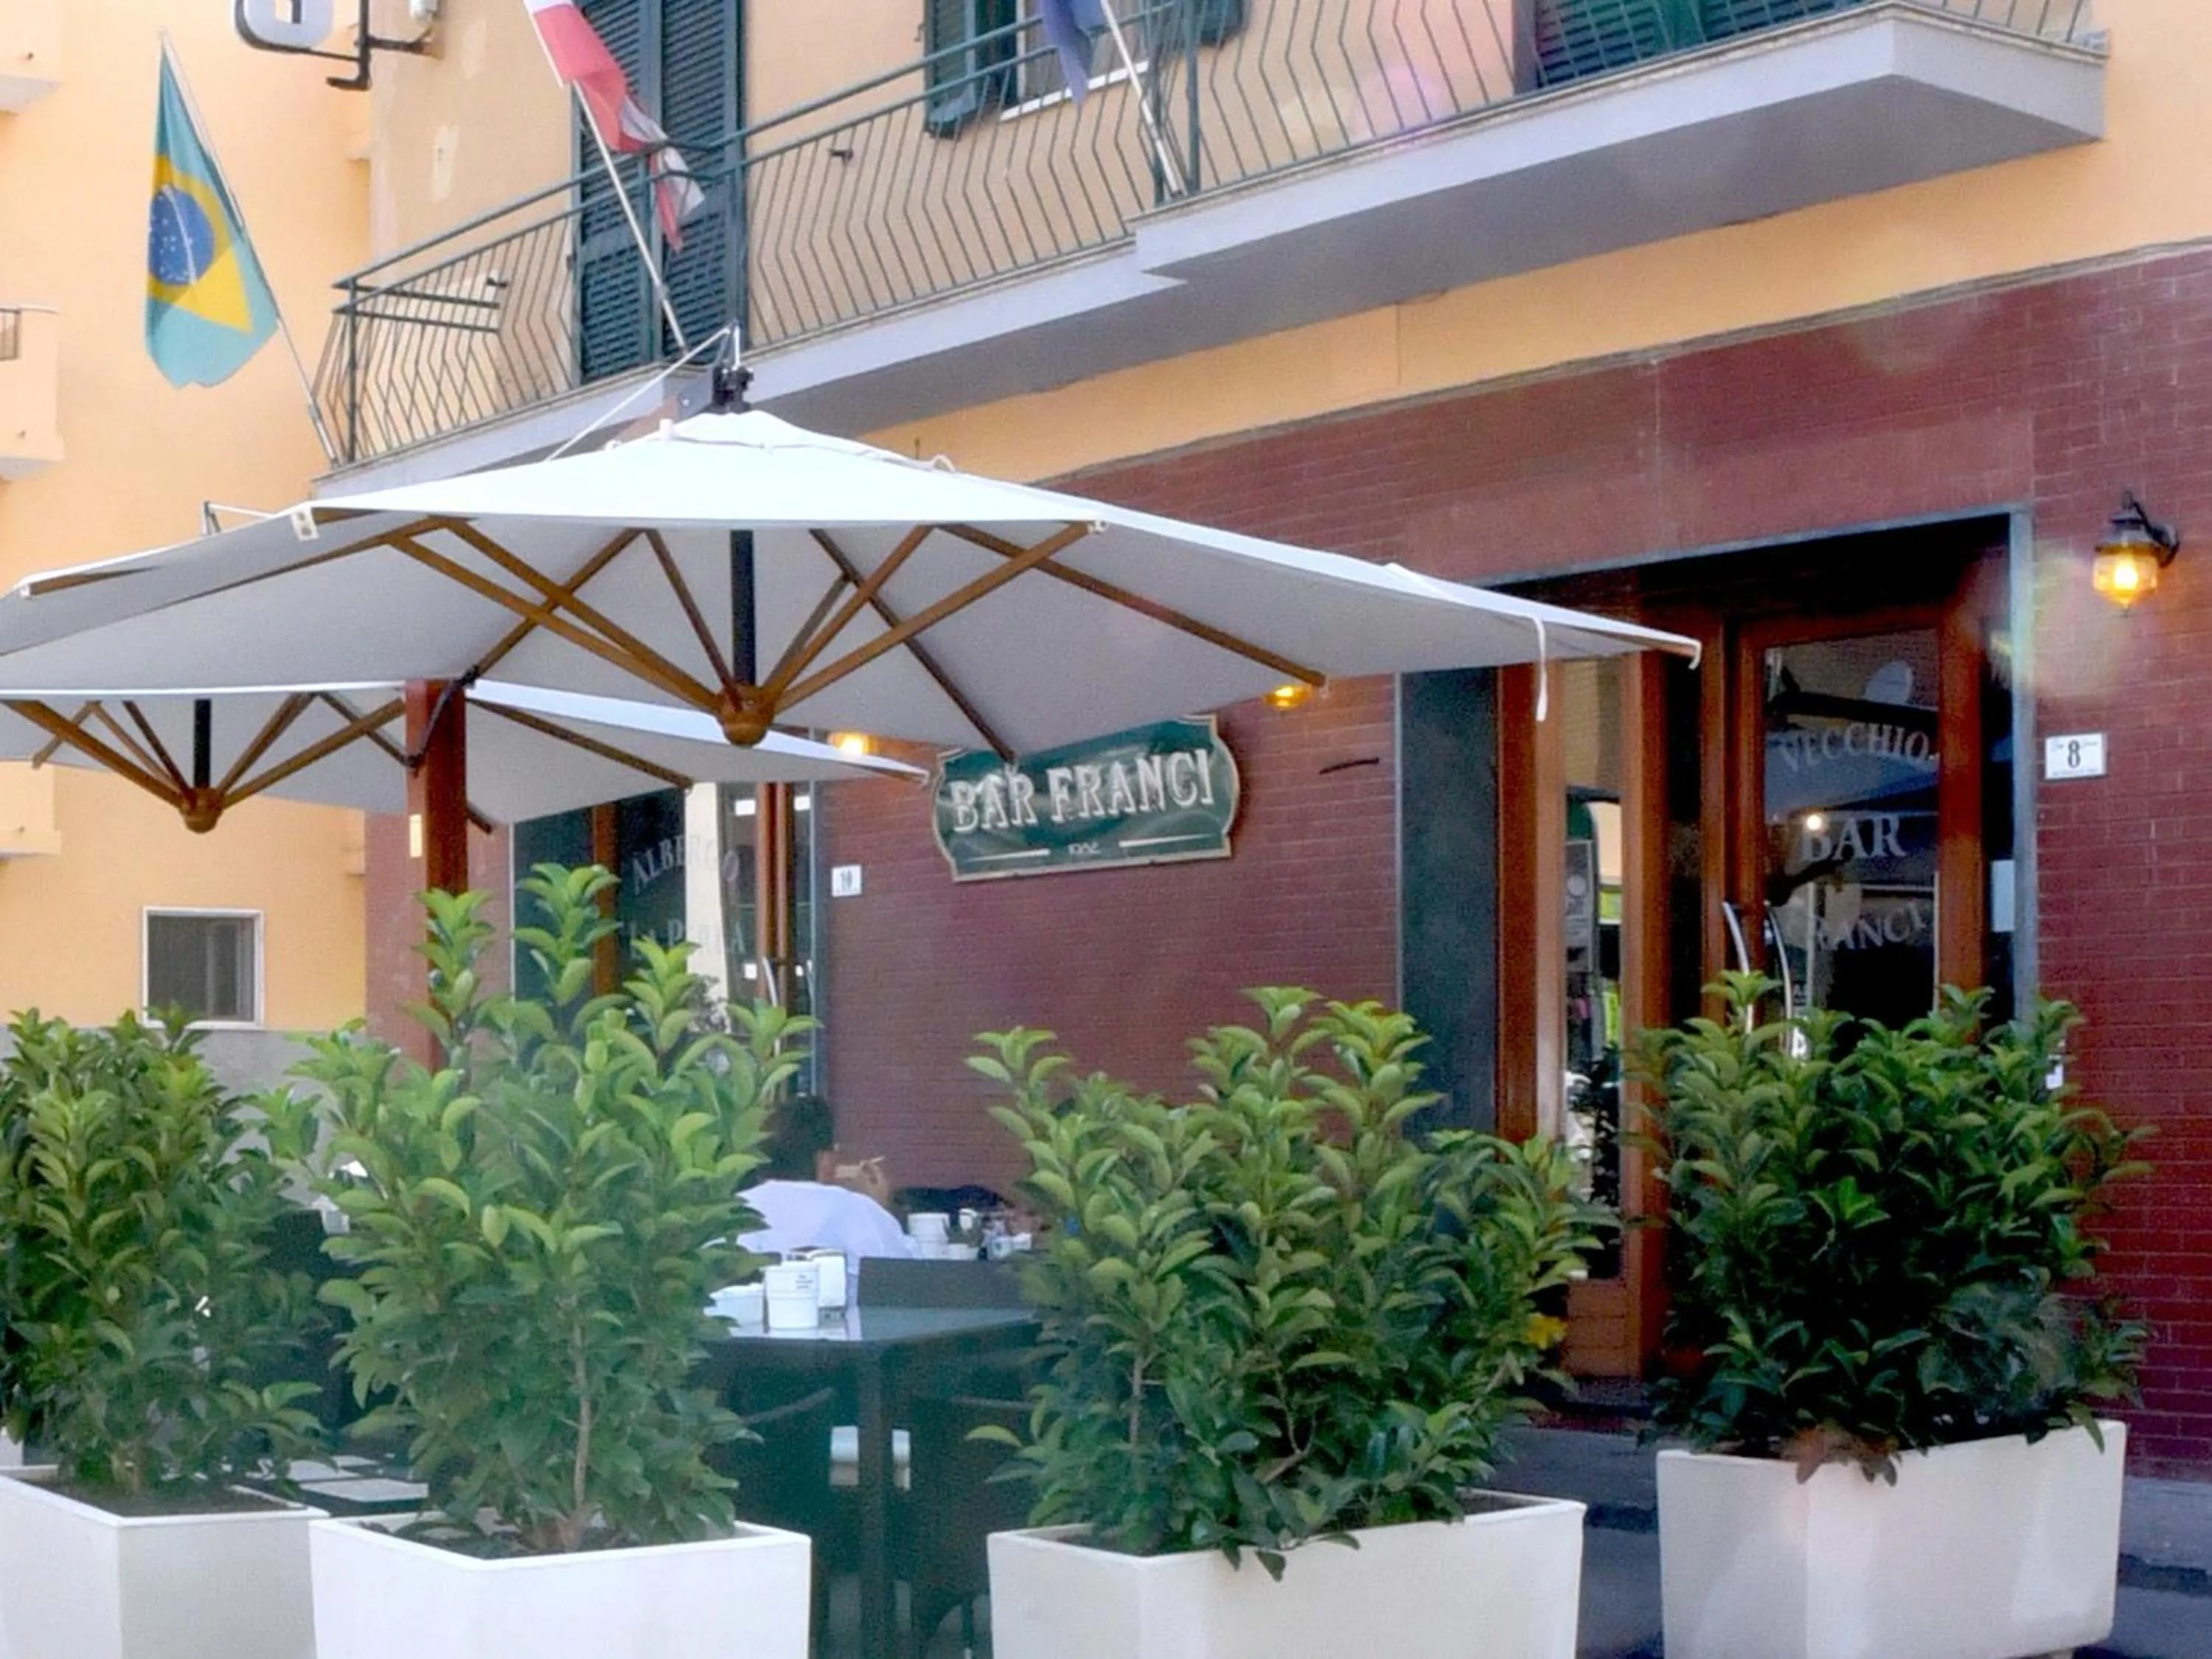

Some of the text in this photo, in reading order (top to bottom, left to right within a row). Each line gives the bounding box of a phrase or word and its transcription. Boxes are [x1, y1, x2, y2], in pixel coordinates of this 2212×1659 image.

[1773, 722, 1930, 773] VECCHIO
[2067, 740, 2081, 768] 8
[949, 748, 1215, 833] BAR FRANCI
[1798, 811, 1907, 863] BAR
